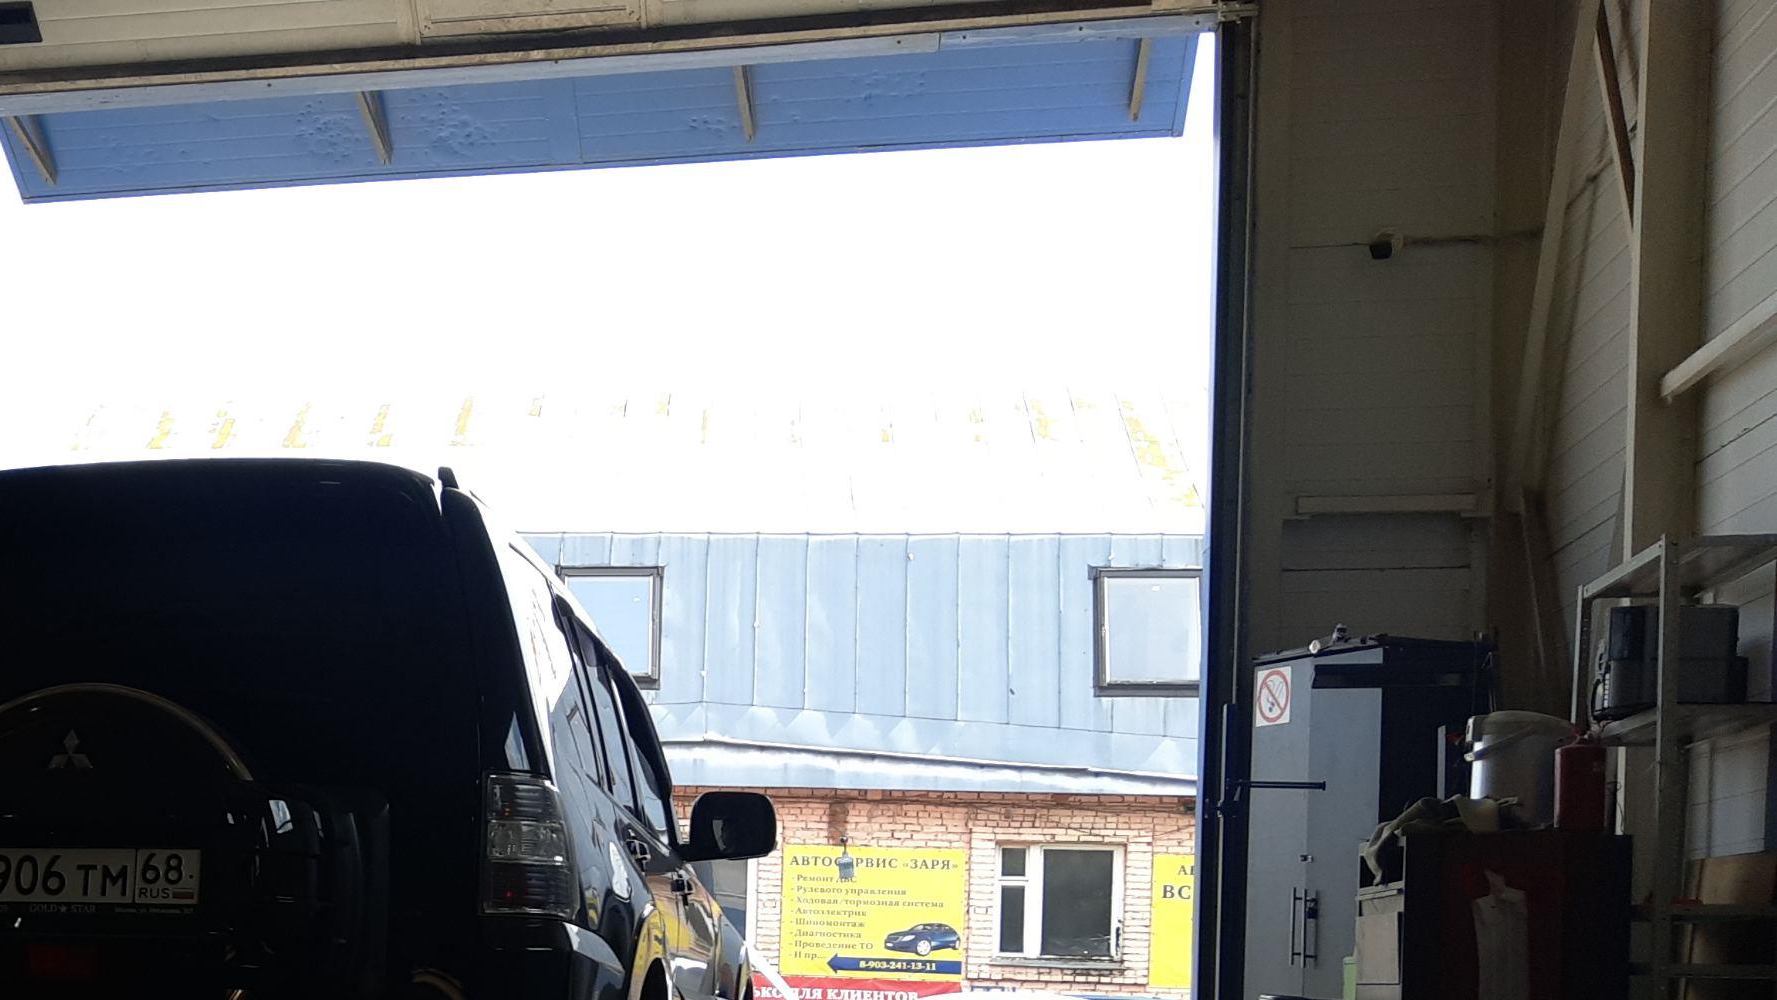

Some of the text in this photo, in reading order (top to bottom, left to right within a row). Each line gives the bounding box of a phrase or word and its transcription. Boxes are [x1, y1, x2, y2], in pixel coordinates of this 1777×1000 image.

[789, 855, 898, 869] АВТОСРВИС
[141, 853, 183, 885] 68
[796, 874, 834, 883] Ремонт
[138, 887, 170, 899] RUS
[796, 885, 907, 896] Рулевого управления
[902, 899, 945, 908] система
[794, 907, 868, 917] Автоэлектрик
[794, 919, 866, 928] Шиномонтаж
[793, 929, 862, 939] Диагностика
[793, 940, 874, 950] Проведение ТО
[859, 960, 937, 971] 8-903-241-13-11
